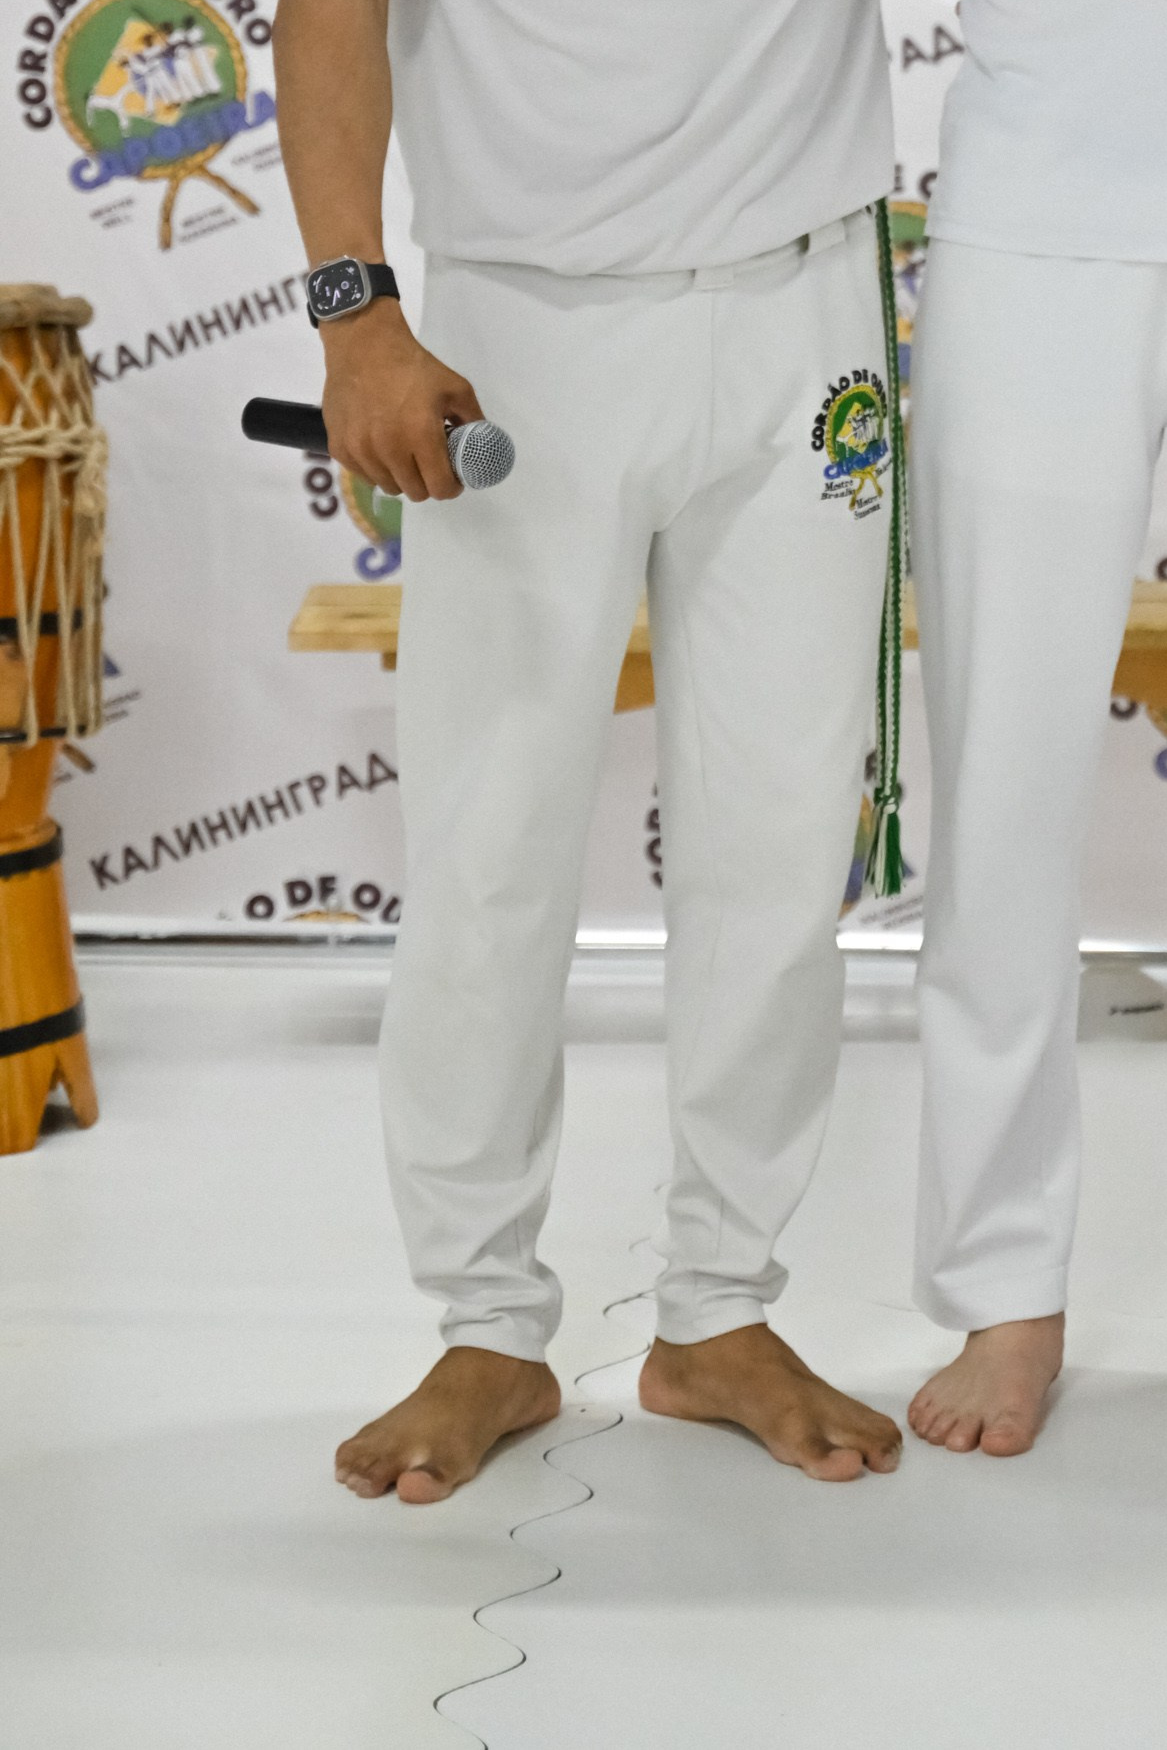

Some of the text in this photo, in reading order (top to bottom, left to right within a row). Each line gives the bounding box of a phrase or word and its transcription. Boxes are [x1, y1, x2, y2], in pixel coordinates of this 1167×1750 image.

[88, 270, 312, 388] КАЛИНИНГ
[811, 376, 850, 452] CORDÃO
[89, 753, 398, 892] КАЛИНИНГРАД
